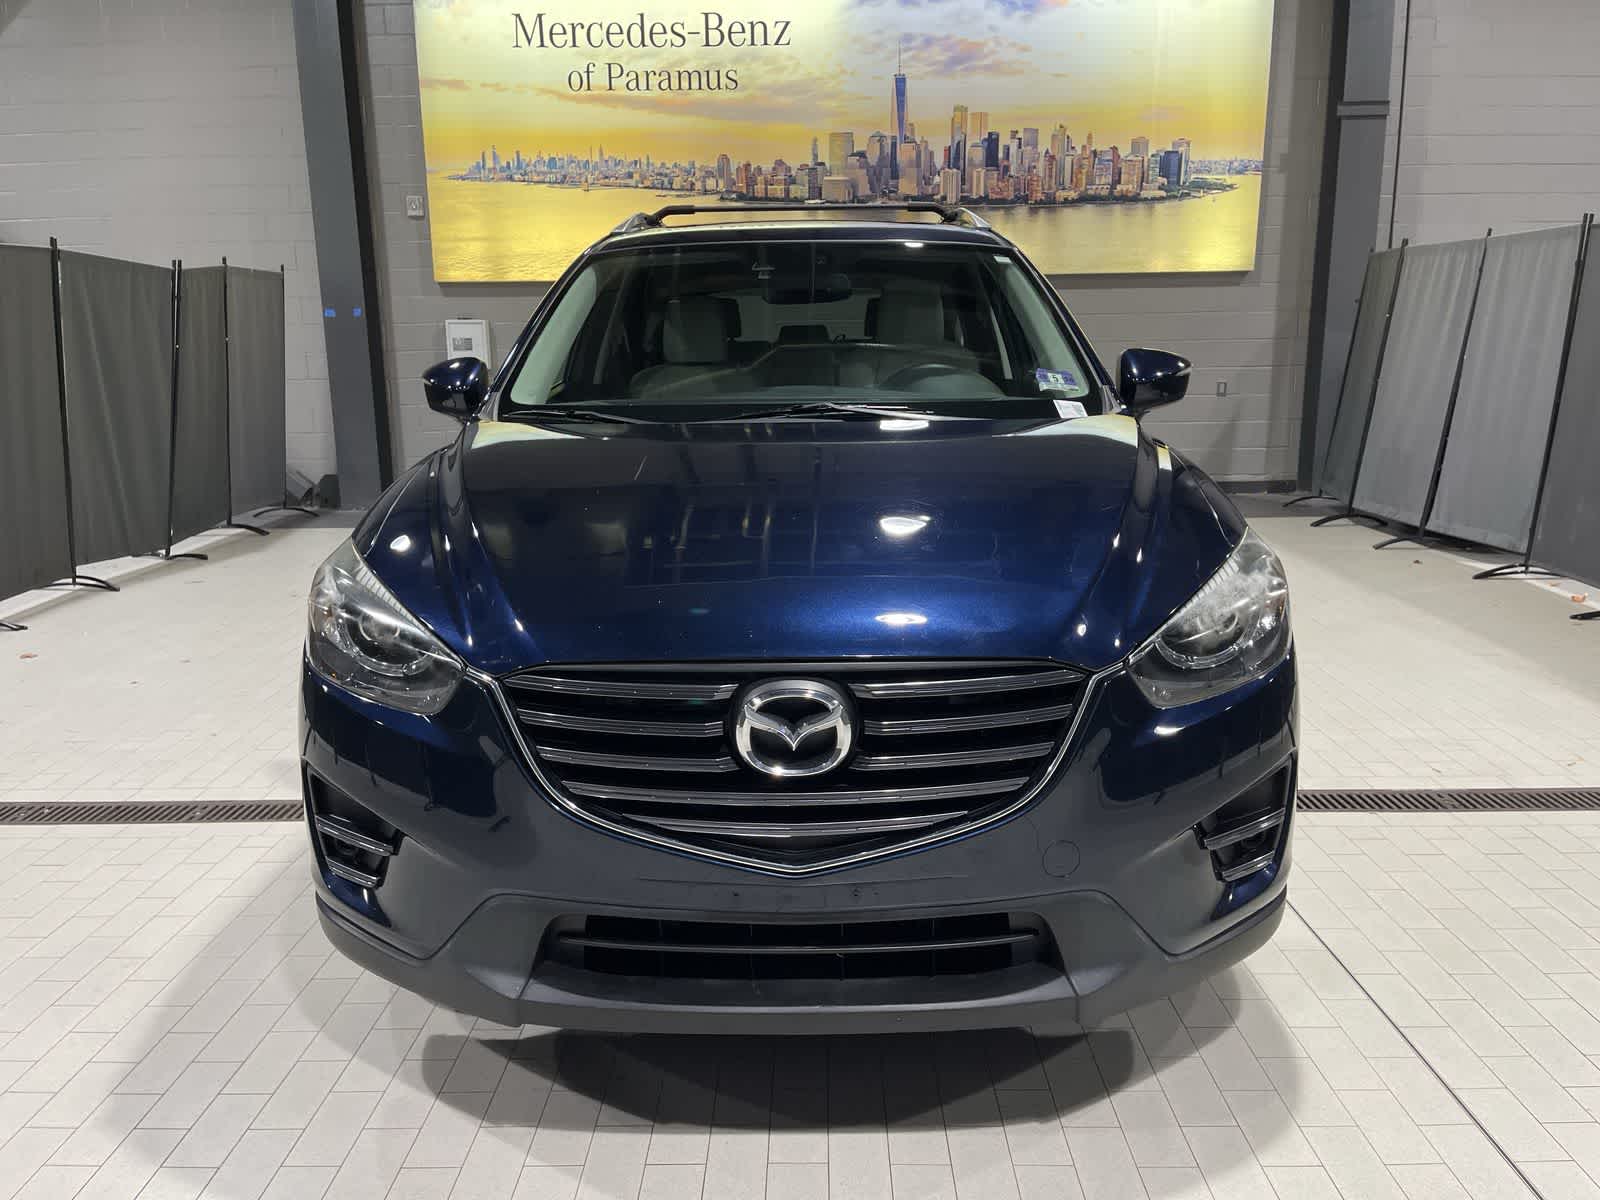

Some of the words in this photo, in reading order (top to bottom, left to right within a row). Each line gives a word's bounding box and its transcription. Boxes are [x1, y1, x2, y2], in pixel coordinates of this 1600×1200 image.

[513, 12, 792, 49] Mercedes-Benz
[568, 62, 596, 92] of
[606, 62, 739, 92] Paramus
